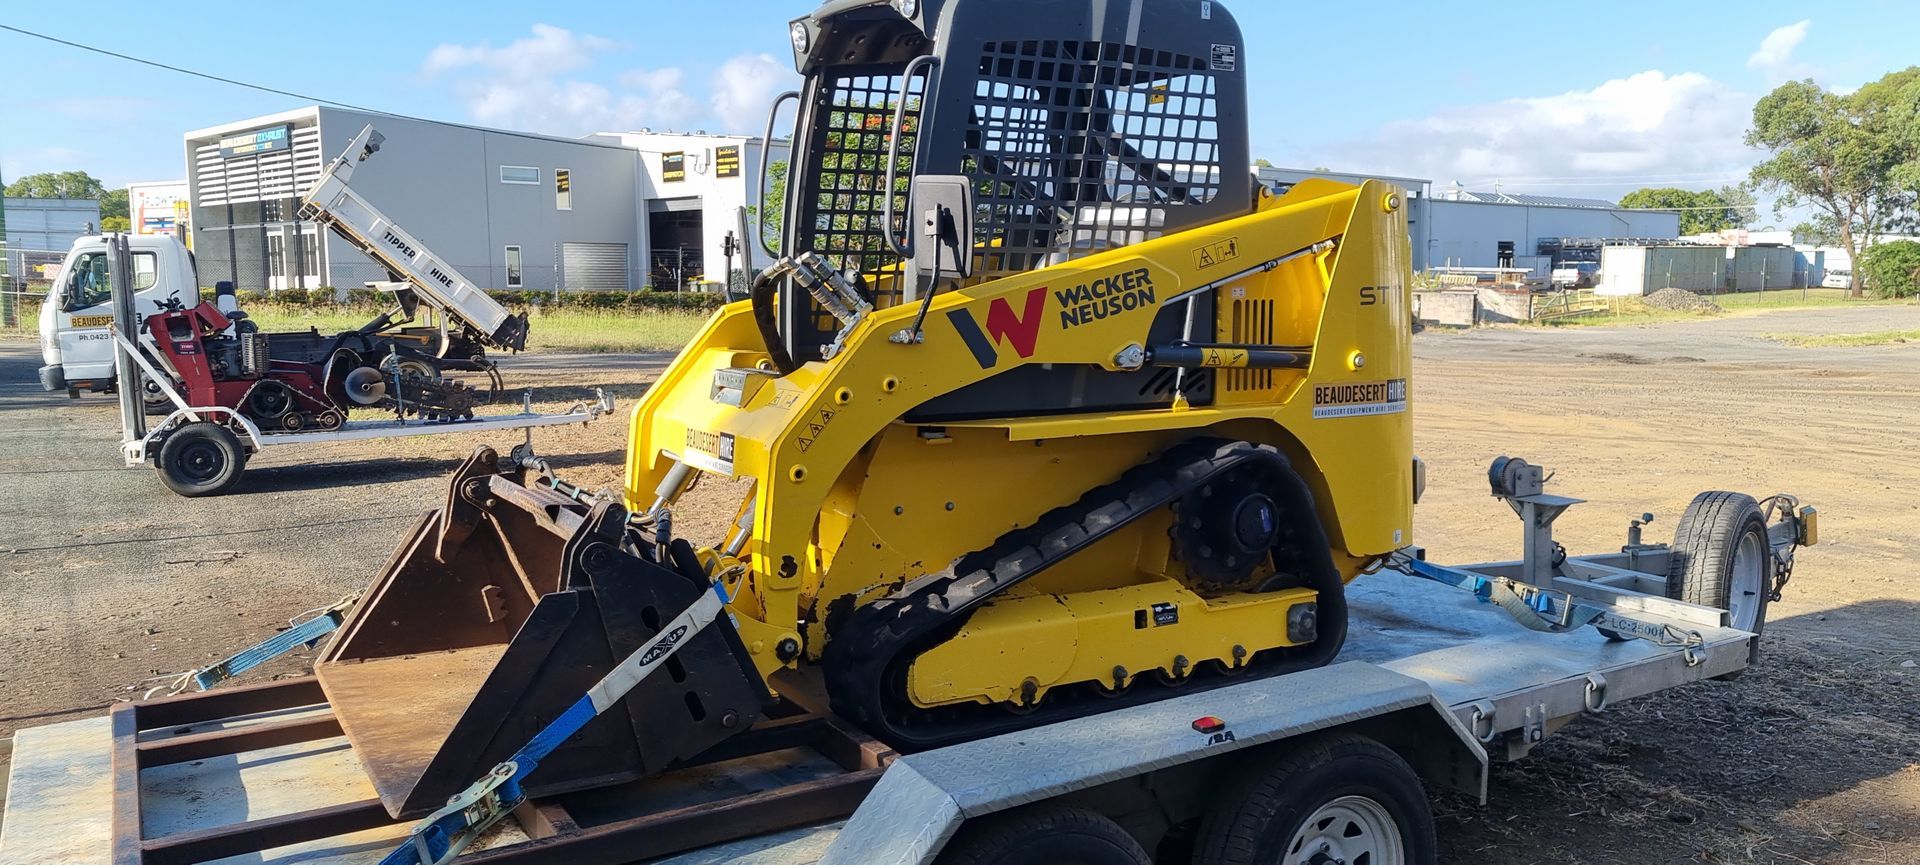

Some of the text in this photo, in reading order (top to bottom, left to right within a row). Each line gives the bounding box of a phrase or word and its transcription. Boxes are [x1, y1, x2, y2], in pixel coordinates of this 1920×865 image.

[384, 231, 416, 259] TIPPER
[430, 268, 454, 288] HIRE
[1054, 267, 1152, 308] WACKER
[1060, 286, 1156, 330] NEUSON
[1315, 381, 1405, 405] BEAUDESERT HIRE
[1314, 408, 1346, 417] BEAUDESERT
[1347, 406, 1375, 414] EQUIPMENT
[686, 427, 734, 460] BEAUDESERT HIRE
[642, 628, 685, 664] MAXUS
